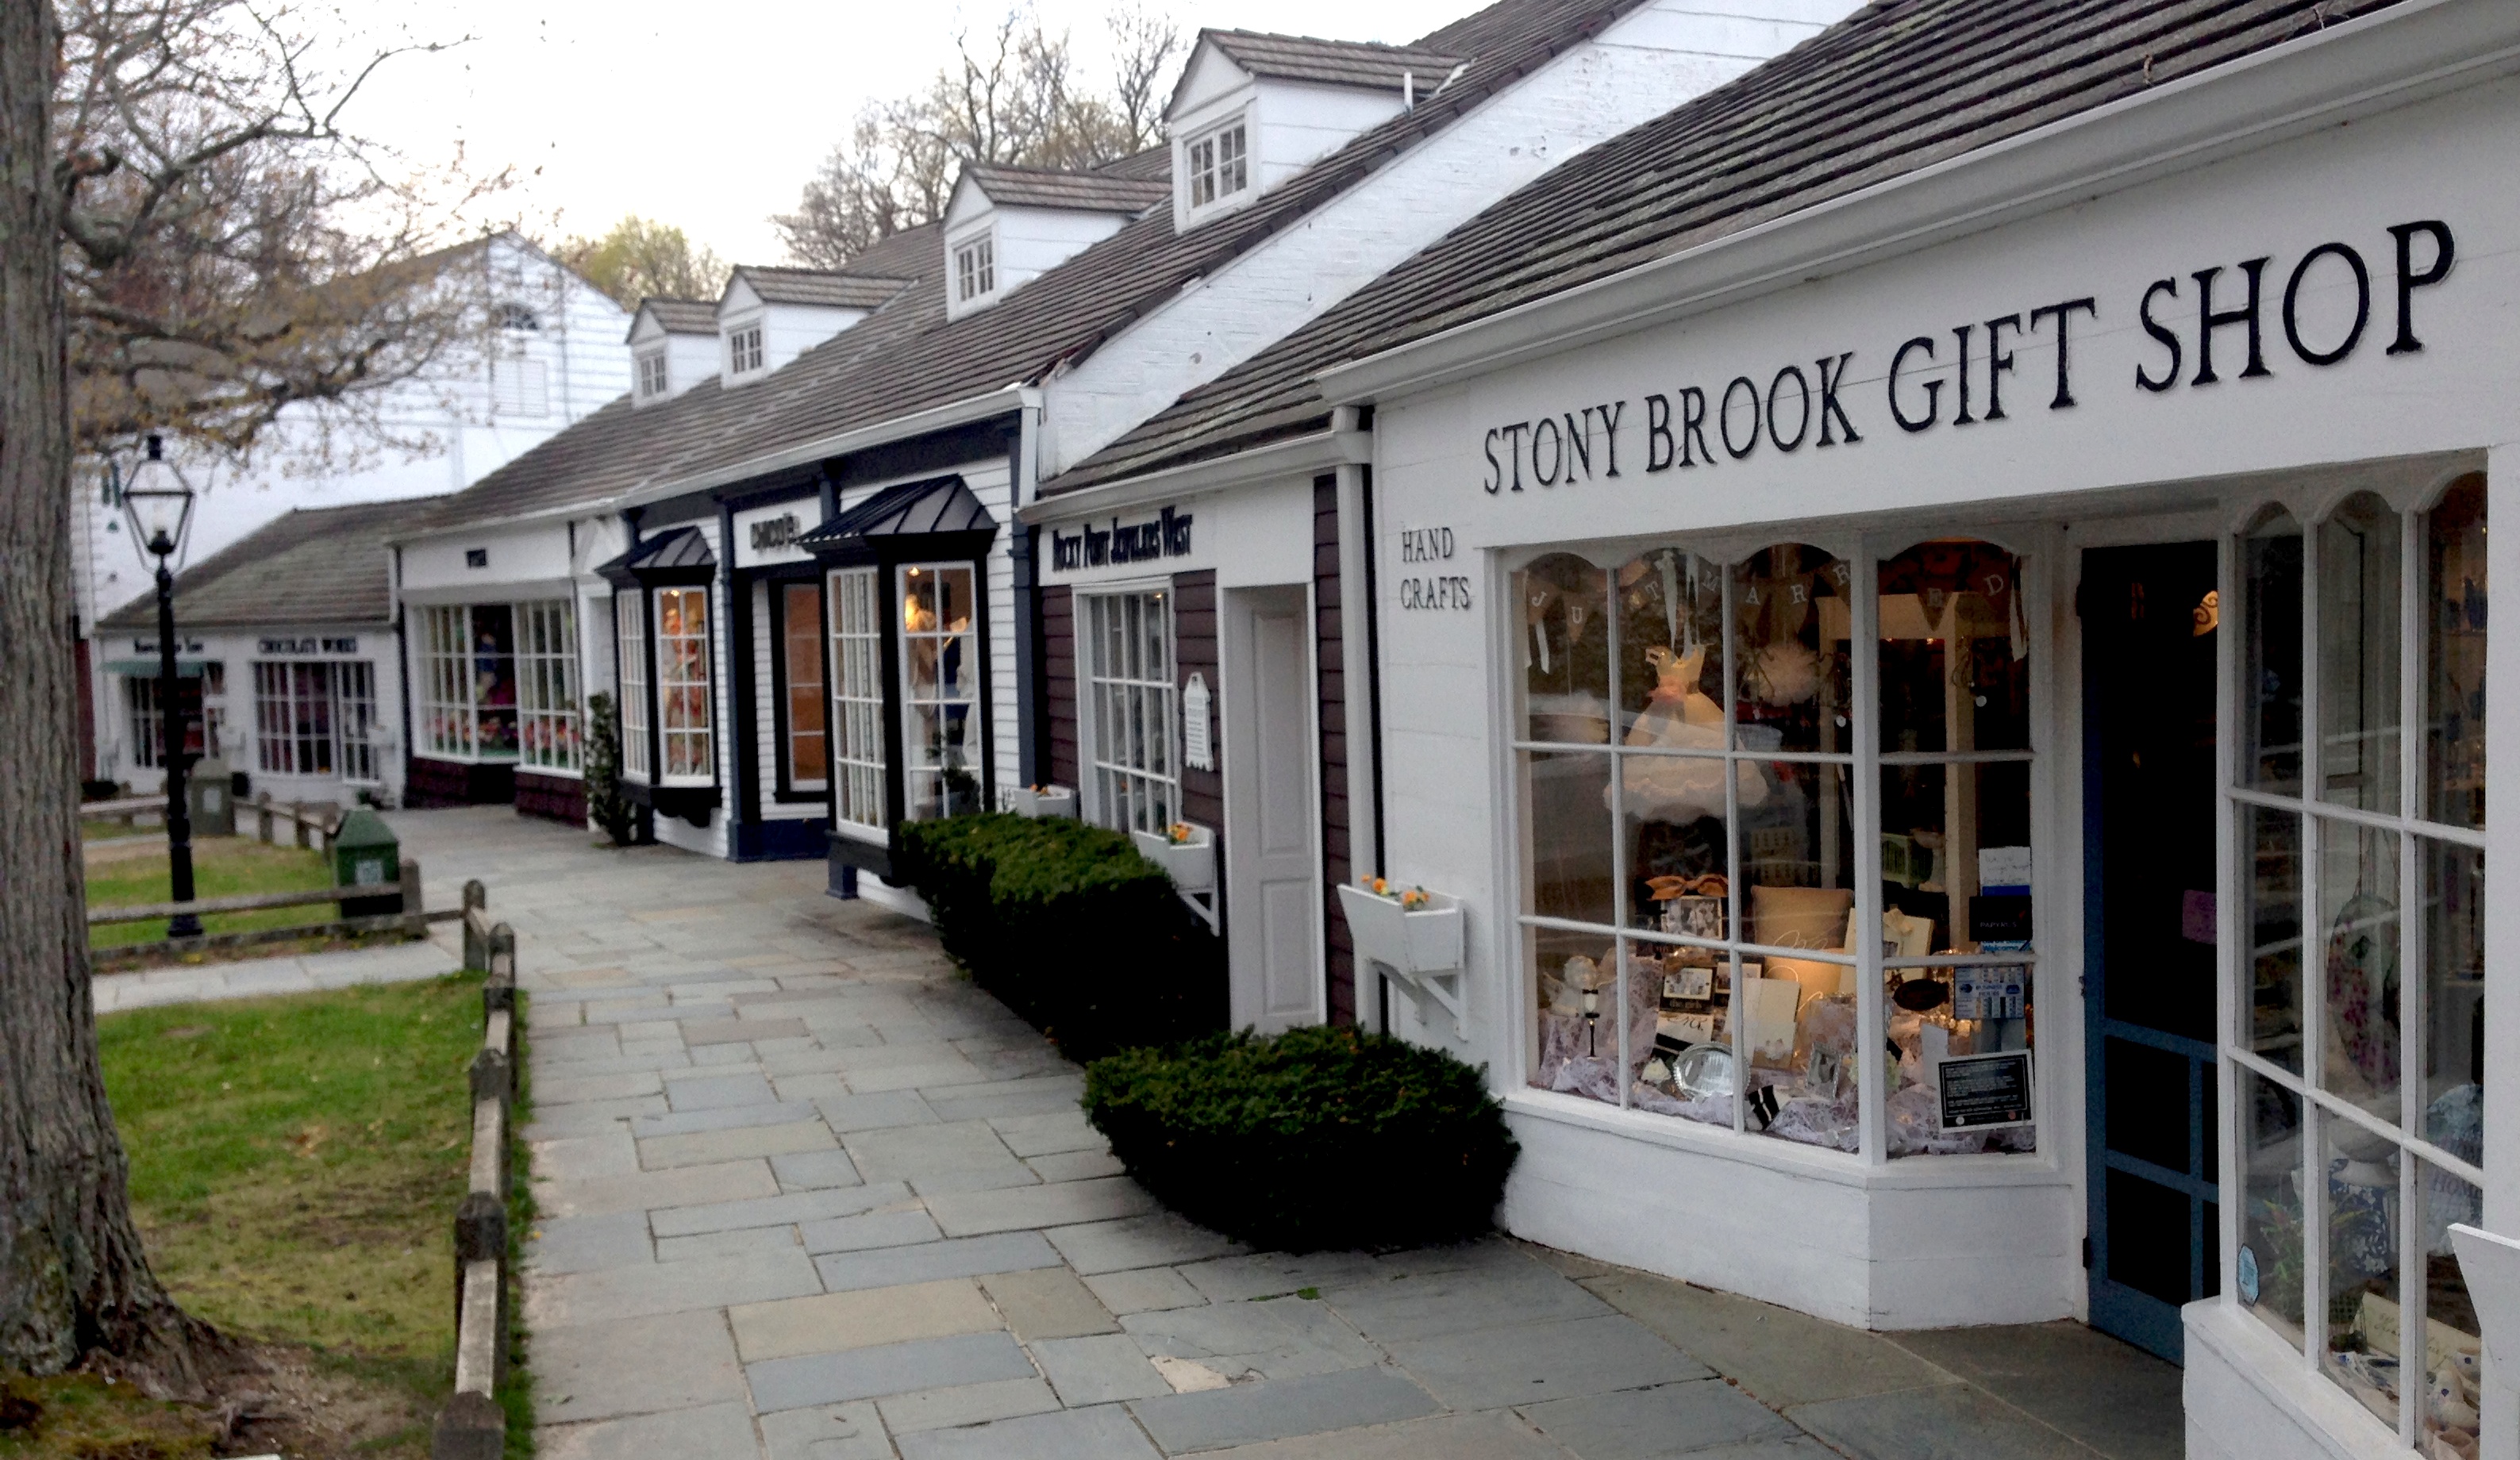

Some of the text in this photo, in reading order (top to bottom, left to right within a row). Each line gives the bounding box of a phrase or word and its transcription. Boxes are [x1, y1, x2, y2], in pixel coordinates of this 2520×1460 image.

[1484, 220, 2455, 495] STONY BROOK GIFT SHOP
[1401, 527, 1453, 563] HAND
[1400, 576, 1472, 610] CRAFTS
